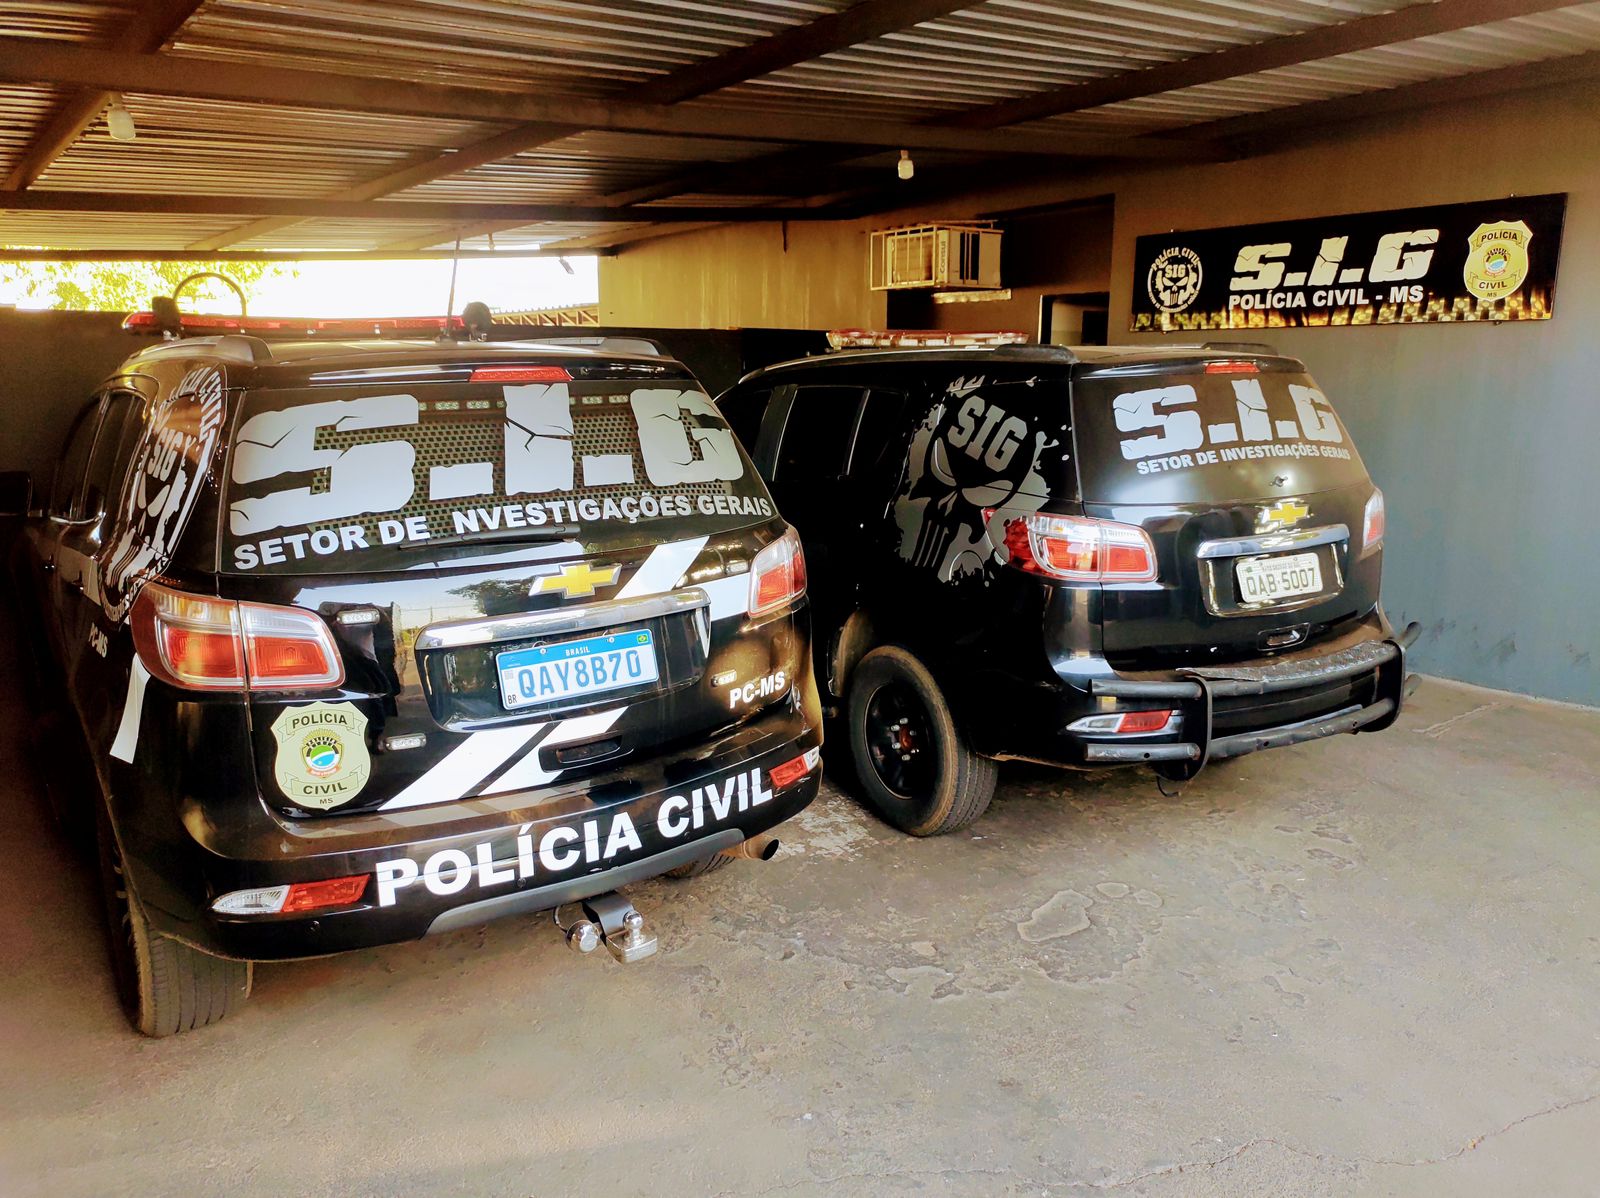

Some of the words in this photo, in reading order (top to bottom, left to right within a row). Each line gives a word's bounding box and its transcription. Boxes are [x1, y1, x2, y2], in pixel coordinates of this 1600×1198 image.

[1480, 230, 1518, 242] POLÍCIA
[1165, 264, 1186, 278] SIG
[1229, 228, 1440, 291] S.I.G
[1229, 290, 1307, 310] POLÍCIA
[1312, 288, 1369, 306] CIVIL
[1389, 285, 1424, 303] MS
[1478, 281, 1508, 290] CIVIL
[948, 395, 1028, 473] SIG
[1112, 378, 1343, 460] S.I.G
[147, 428, 184, 482] SIG
[230, 383, 744, 536] S.I.G
[1136, 453, 1194, 475] SETOR
[1199, 451, 1219, 465] DE
[1223, 442, 1320, 463] INVESTIGAÇÕES
[1320, 446, 1351, 460] GERAIS
[233, 525, 370, 570] SETOR
[378, 515, 432, 545] DE
[698, 494, 772, 516] GERAIS
[565, 646, 591, 656] BRASIL
[518, 649, 642, 699] QAY8B70
[729, 671, 786, 710] PC-MS
[507, 694, 518, 705] BR
[292, 711, 348, 729] POLÍCIA
[303, 782, 348, 795] CIVIL
[375, 811, 642, 908] POLÍCIA
[656, 767, 773, 839] CIVIL
